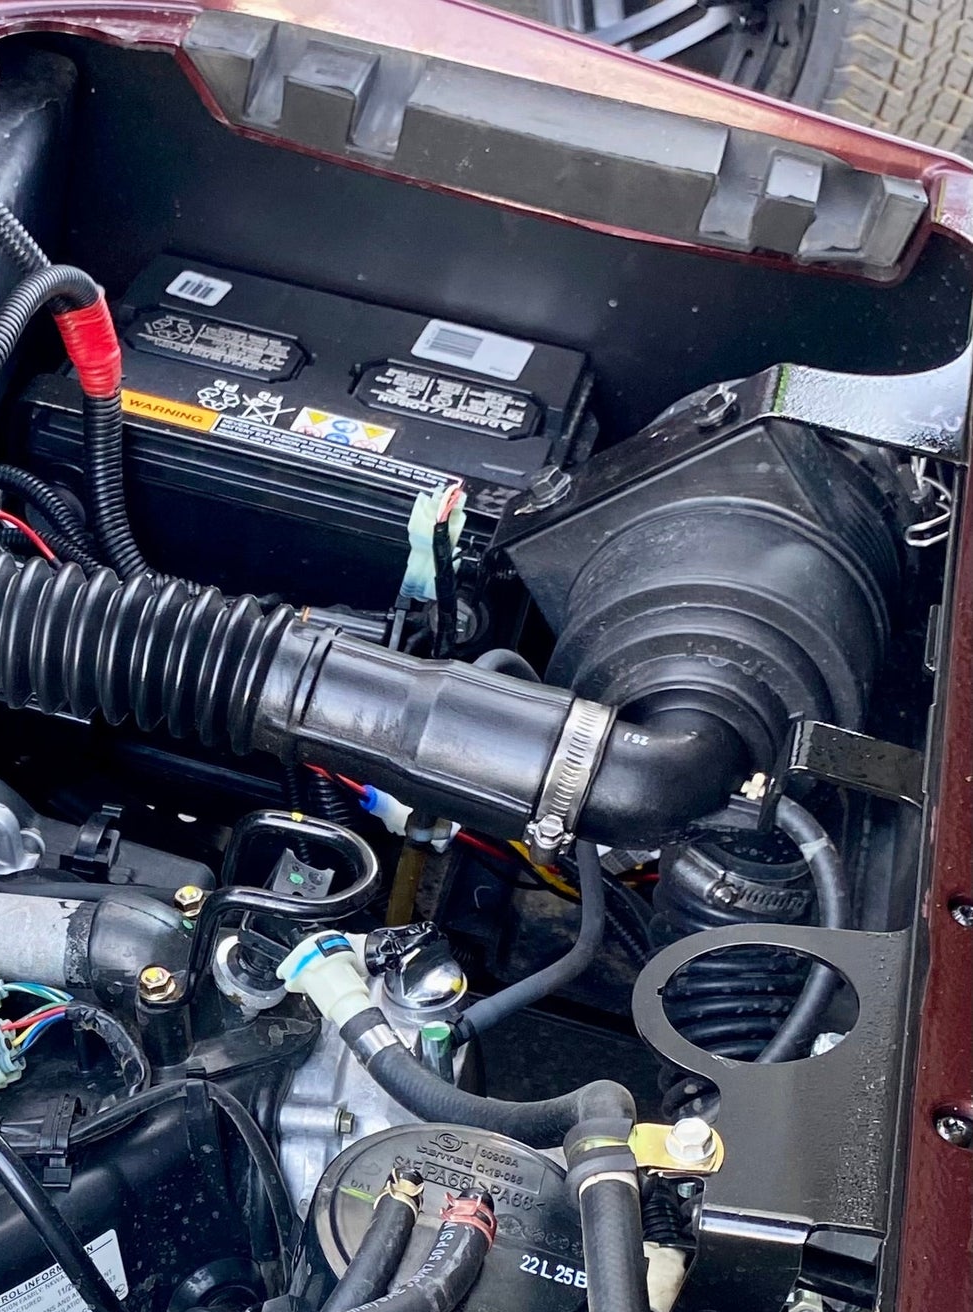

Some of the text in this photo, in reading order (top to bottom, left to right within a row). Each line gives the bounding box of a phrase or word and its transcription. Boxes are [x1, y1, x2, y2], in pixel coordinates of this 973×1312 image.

[129, 398, 204, 424] WARNING
[425, 1164, 472, 1190] PA66
[435, 1227, 456, 1250] PSI
[428, 1246, 445, 1264] 50
[56, 1296, 70, 1308] AND
